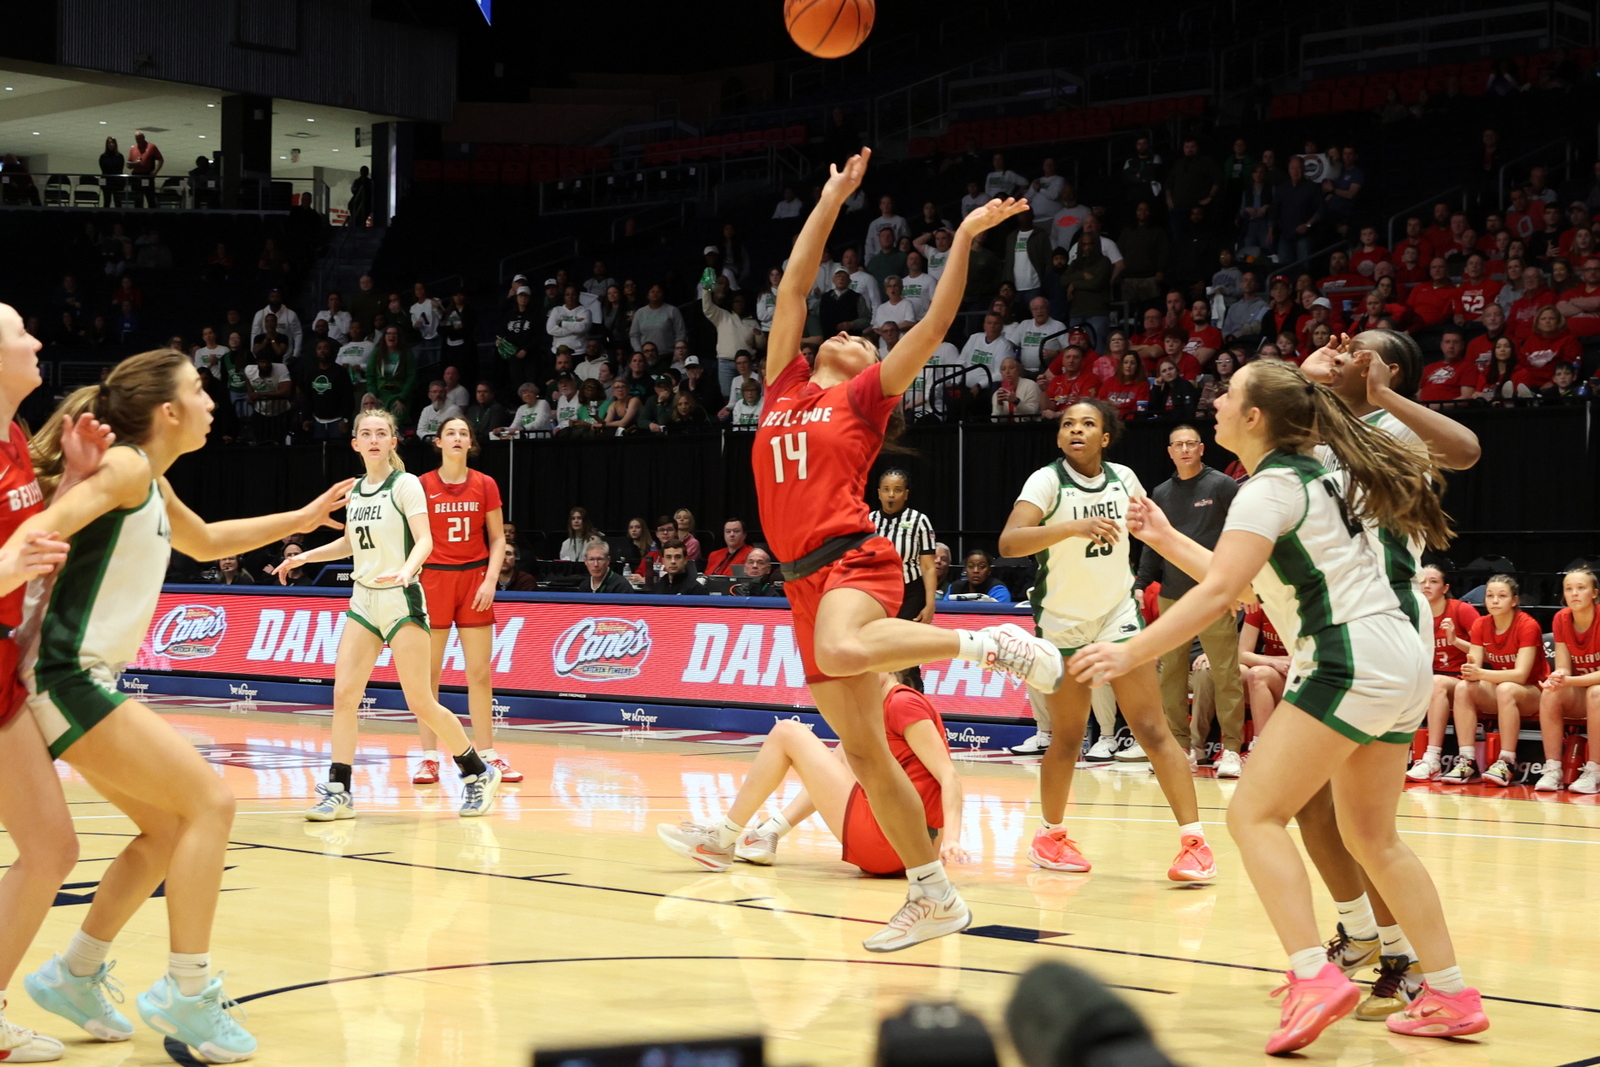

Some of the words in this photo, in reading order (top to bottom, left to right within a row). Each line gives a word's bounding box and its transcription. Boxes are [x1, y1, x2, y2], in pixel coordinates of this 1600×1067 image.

[770, 431, 807, 483] 14
[349, 505, 382, 522] LAUREL
[434, 501, 480, 513] BELLEVUE
[355, 525, 376, 550] 21
[447, 517, 471, 542] 21
[681, 622, 806, 688] DAN
[238, 683, 258, 702] Kroger
[491, 699, 511, 717] roger
[632, 708, 658, 727] Kroger
[958, 728, 990, 748] Kroger
